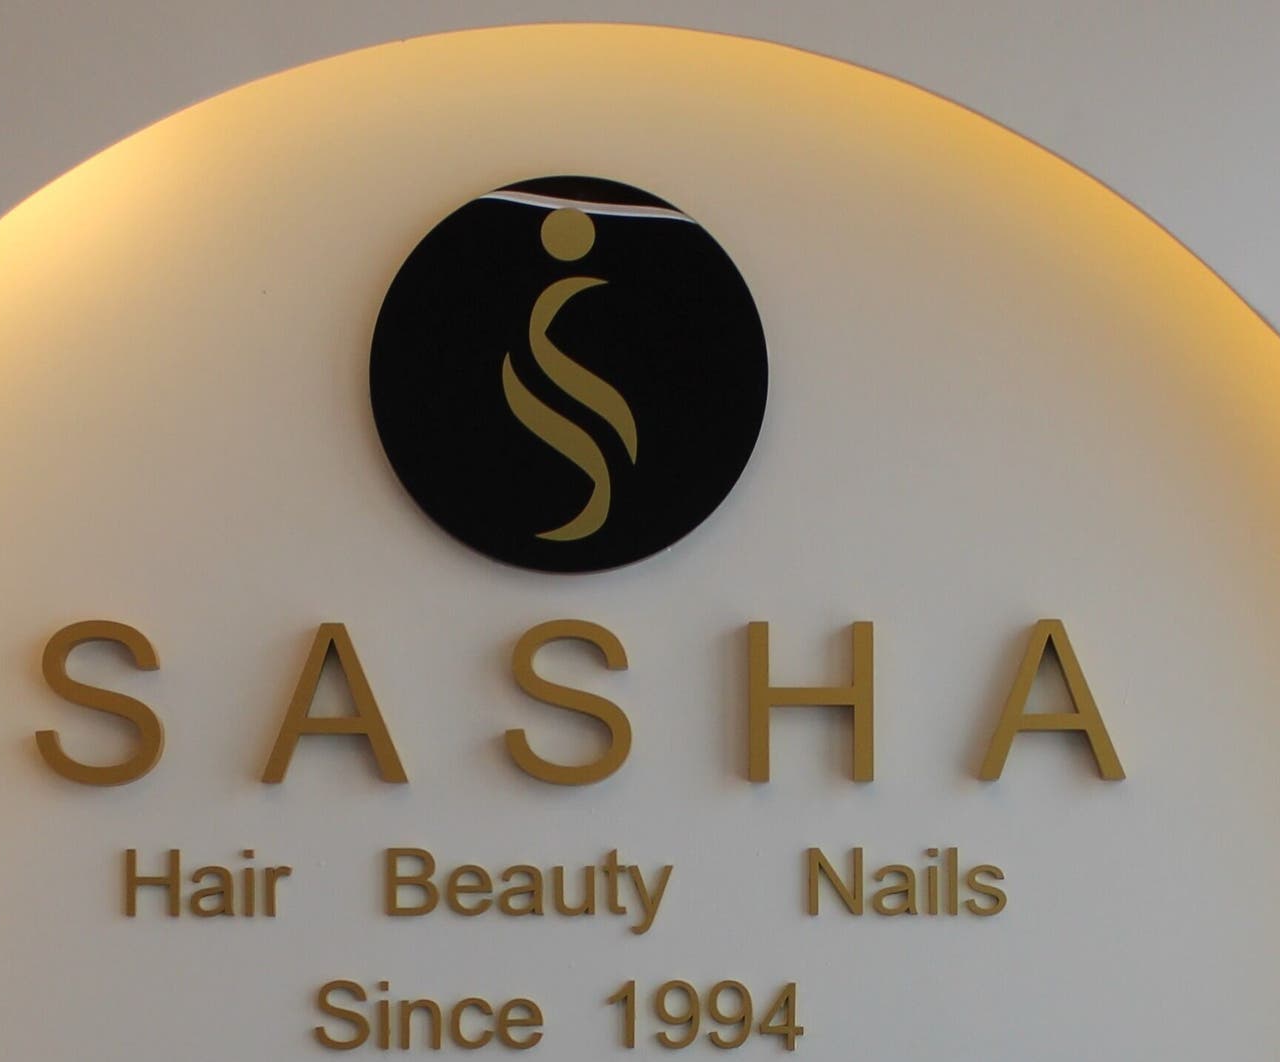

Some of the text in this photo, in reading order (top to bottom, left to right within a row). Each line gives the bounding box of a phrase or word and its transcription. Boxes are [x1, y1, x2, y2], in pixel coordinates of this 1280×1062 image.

[33, 618, 1127, 787] SASHA
[120, 845, 1009, 936] Hair Beauty Nails
[313, 979, 806, 1053] Since 1994
